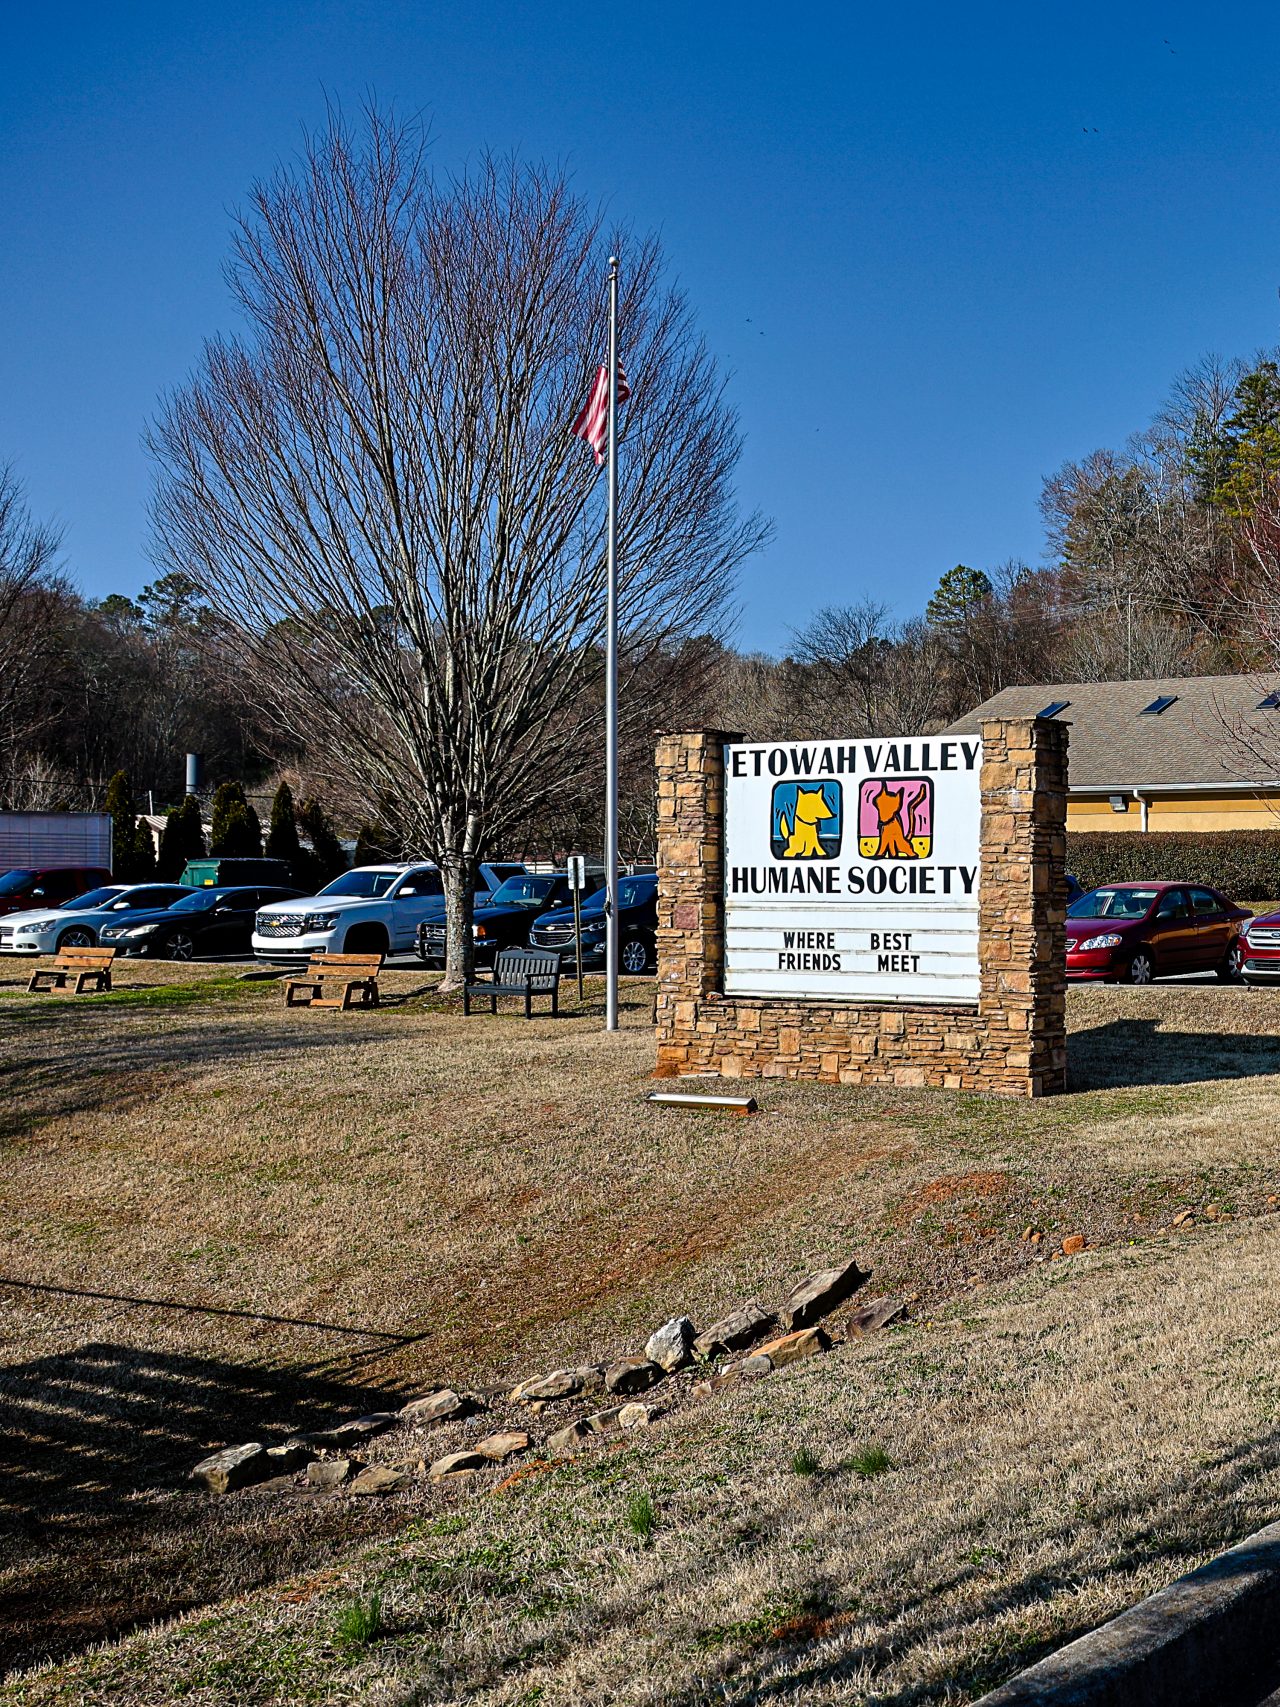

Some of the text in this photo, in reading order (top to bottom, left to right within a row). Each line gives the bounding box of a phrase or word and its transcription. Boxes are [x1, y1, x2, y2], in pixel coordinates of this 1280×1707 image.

[732, 742, 980, 777] ETOWAH VALLEY
[732, 866, 978, 894] HUMANE SOCIETY
[783, 931, 912, 951] WHERE BEST
[778, 952, 920, 973] FRIENDS MEET
